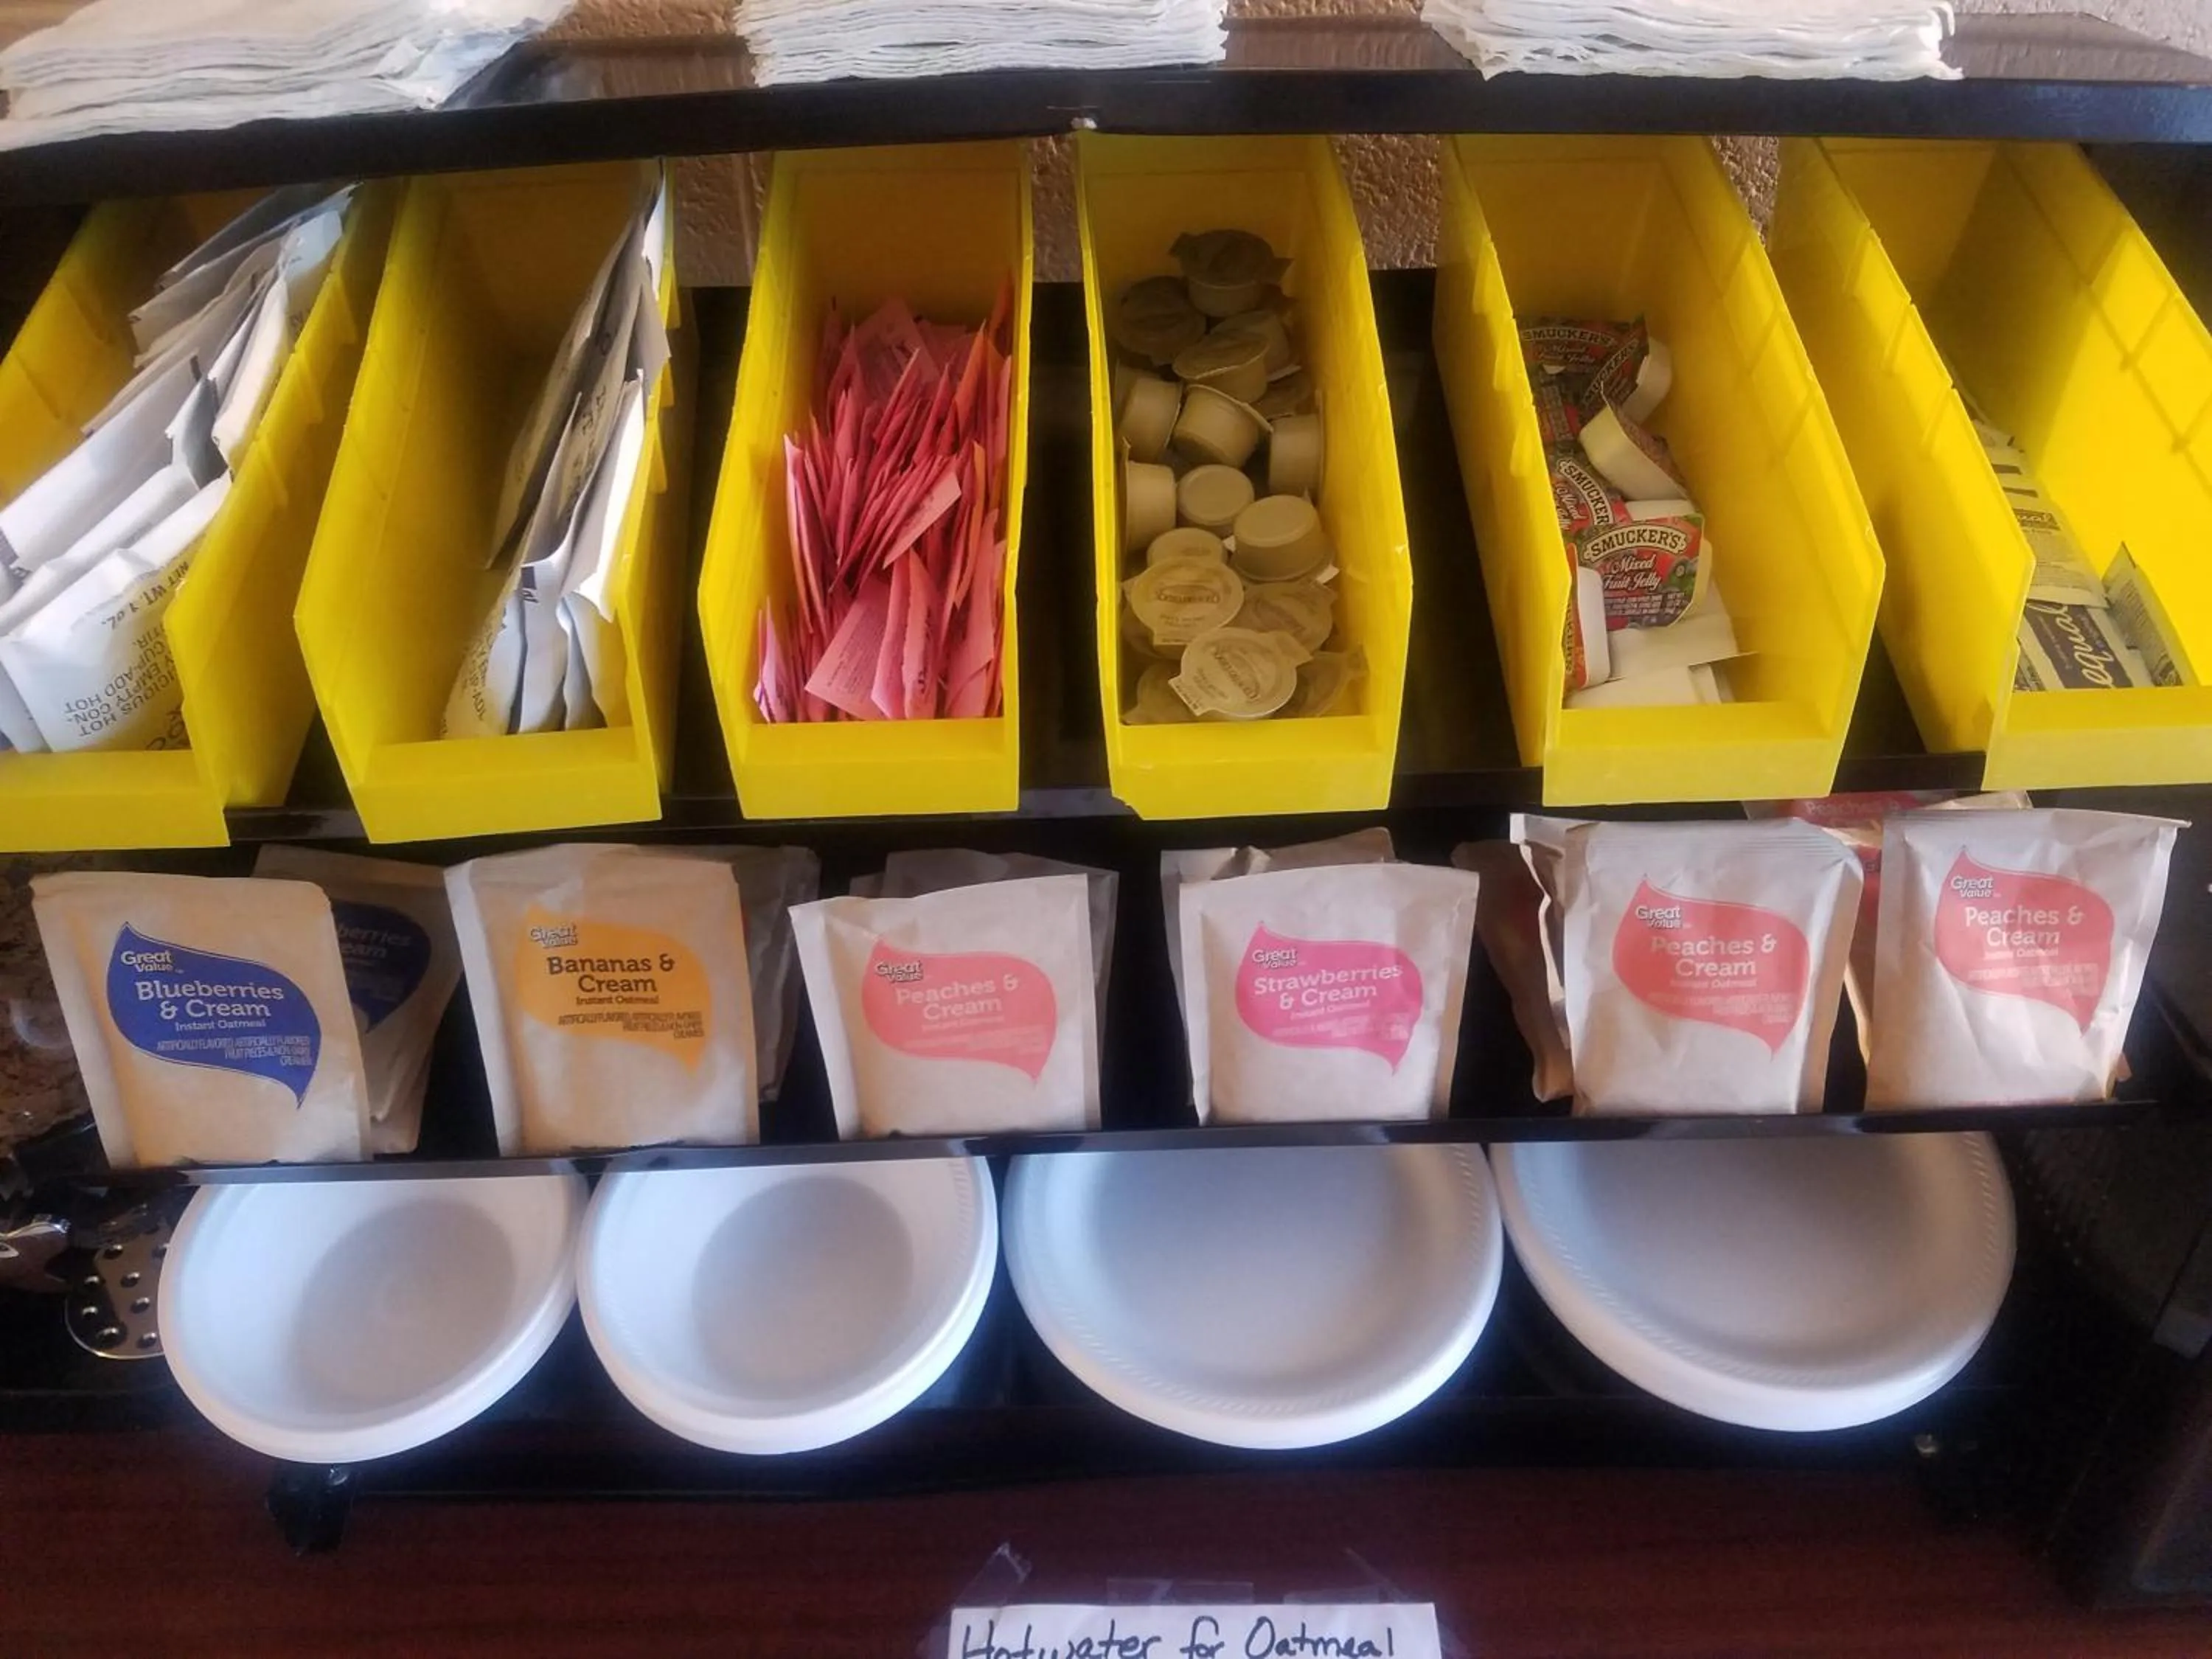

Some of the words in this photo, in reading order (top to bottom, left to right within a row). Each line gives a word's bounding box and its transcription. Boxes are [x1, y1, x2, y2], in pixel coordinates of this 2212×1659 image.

[1564, 465, 1610, 525] SMUCKER
[1590, 528, 1682, 557] SMUCKER'S
[1611, 554, 1656, 574] Mixed
[1629, 571, 1662, 591] Jelly
[116, 661, 159, 706] EMPTY
[120, 667, 175, 715] ICIOUS
[63, 693, 102, 714] HOT
[66, 702, 111, 724] CON-
[78, 713, 117, 737] HOT
[1950, 875, 1994, 890] Great
[1959, 887, 1992, 898] Value
[1635, 905, 1682, 920] Great
[1965, 905, 2060, 928] Peaches
[2067, 905, 2085, 926] &
[529, 922, 578, 942] Great
[1648, 918, 1682, 930] Value
[336, 924, 414, 946] berries
[1651, 934, 1755, 956] Peaches
[1761, 933, 1777, 953] &
[1986, 927, 2060, 947] Cream
[120, 949, 173, 966] Great
[547, 956, 653, 976] Bananas
[658, 953, 675, 973] &
[1253, 947, 1298, 964] Great
[135, 962, 173, 974] Value
[874, 961, 922, 975] Great
[886, 971, 922, 984] Value
[1674, 958, 1756, 977] Cream
[577, 974, 658, 993] Cream
[894, 978, 997, 1006] Peaches
[1003, 974, 1020, 992] &
[1255, 964, 1404, 995] Strawberries
[135, 980, 285, 1002] Blueberries
[1279, 992, 1295, 1011] &
[1301, 985, 1377, 1007] Cream
[159, 1000, 178, 1020] &
[185, 999, 271, 1018] Cream
[922, 996, 1002, 1021] Cream
[175, 1020, 215, 1032] Instant
[218, 1018, 267, 1030] Oatmeal
[1180, 1615, 1225, 1659] for
[1245, 1615, 1395, 1659] Oatmeal
